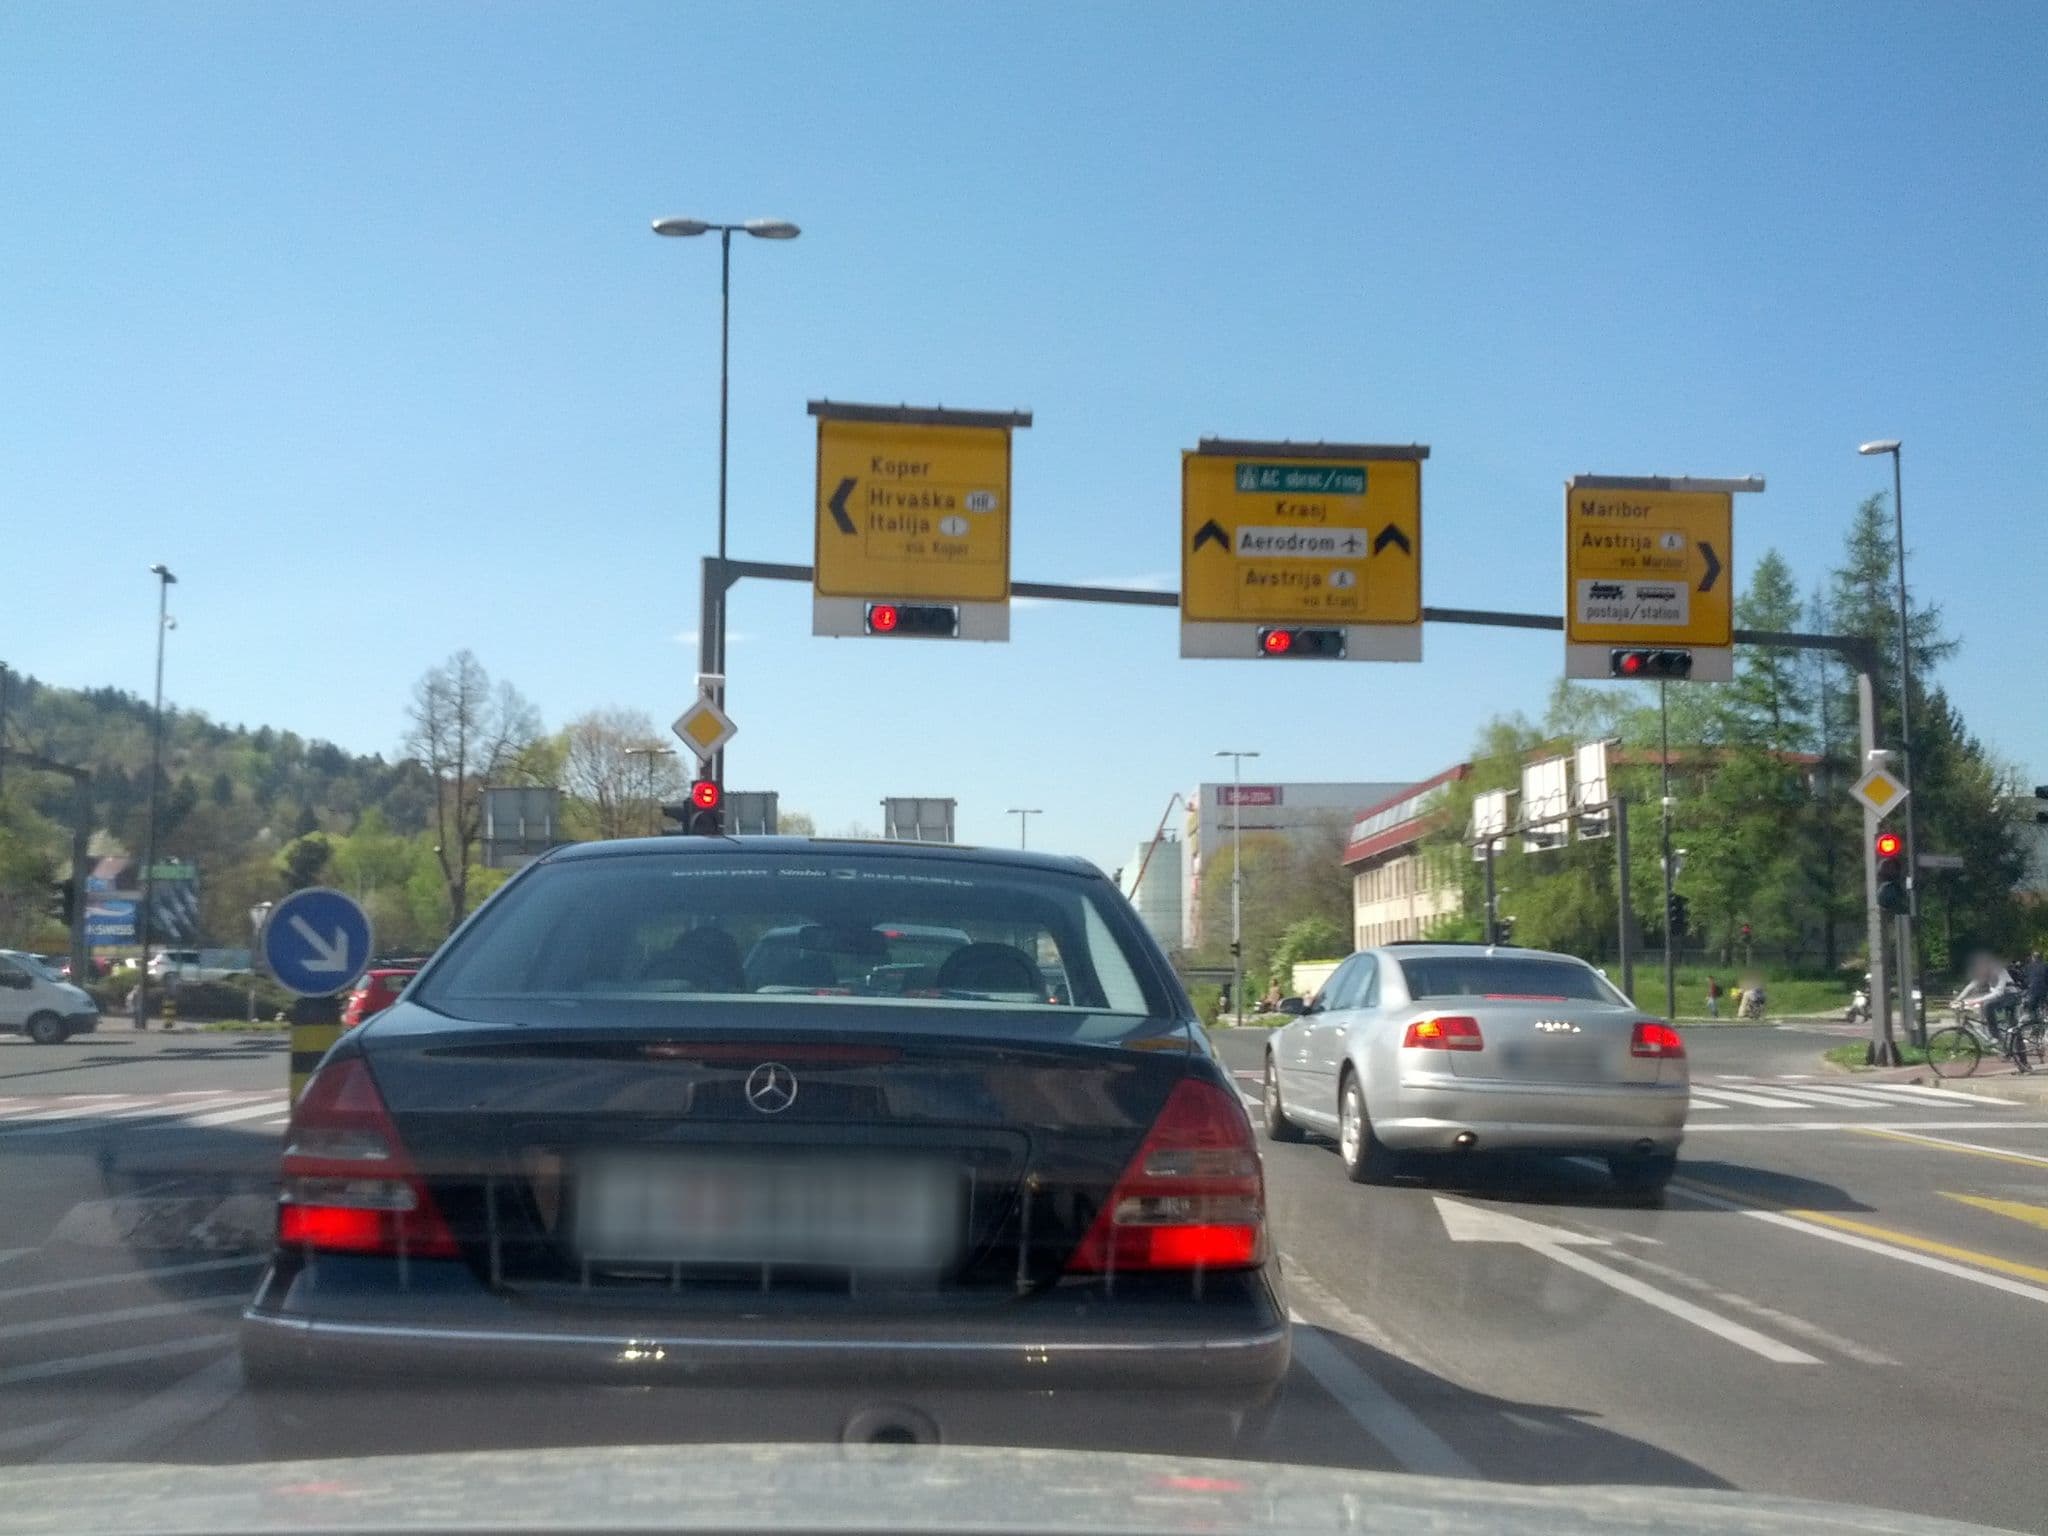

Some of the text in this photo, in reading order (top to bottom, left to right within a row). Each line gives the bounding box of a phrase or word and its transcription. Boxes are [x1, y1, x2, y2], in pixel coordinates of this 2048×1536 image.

[870, 456, 931, 479] Koper
[869, 487, 956, 510] Hrvaška
[1276, 500, 1327, 522] Kranj
[1581, 501, 1650, 519] Maribor
[869, 513, 931, 536] Italija
[1240, 532, 1336, 552] Aerodrom
[1581, 531, 1653, 553] Avstrija
[1246, 569, 1322, 590] Avstrija
[1586, 604, 1681, 621] postaja/station
